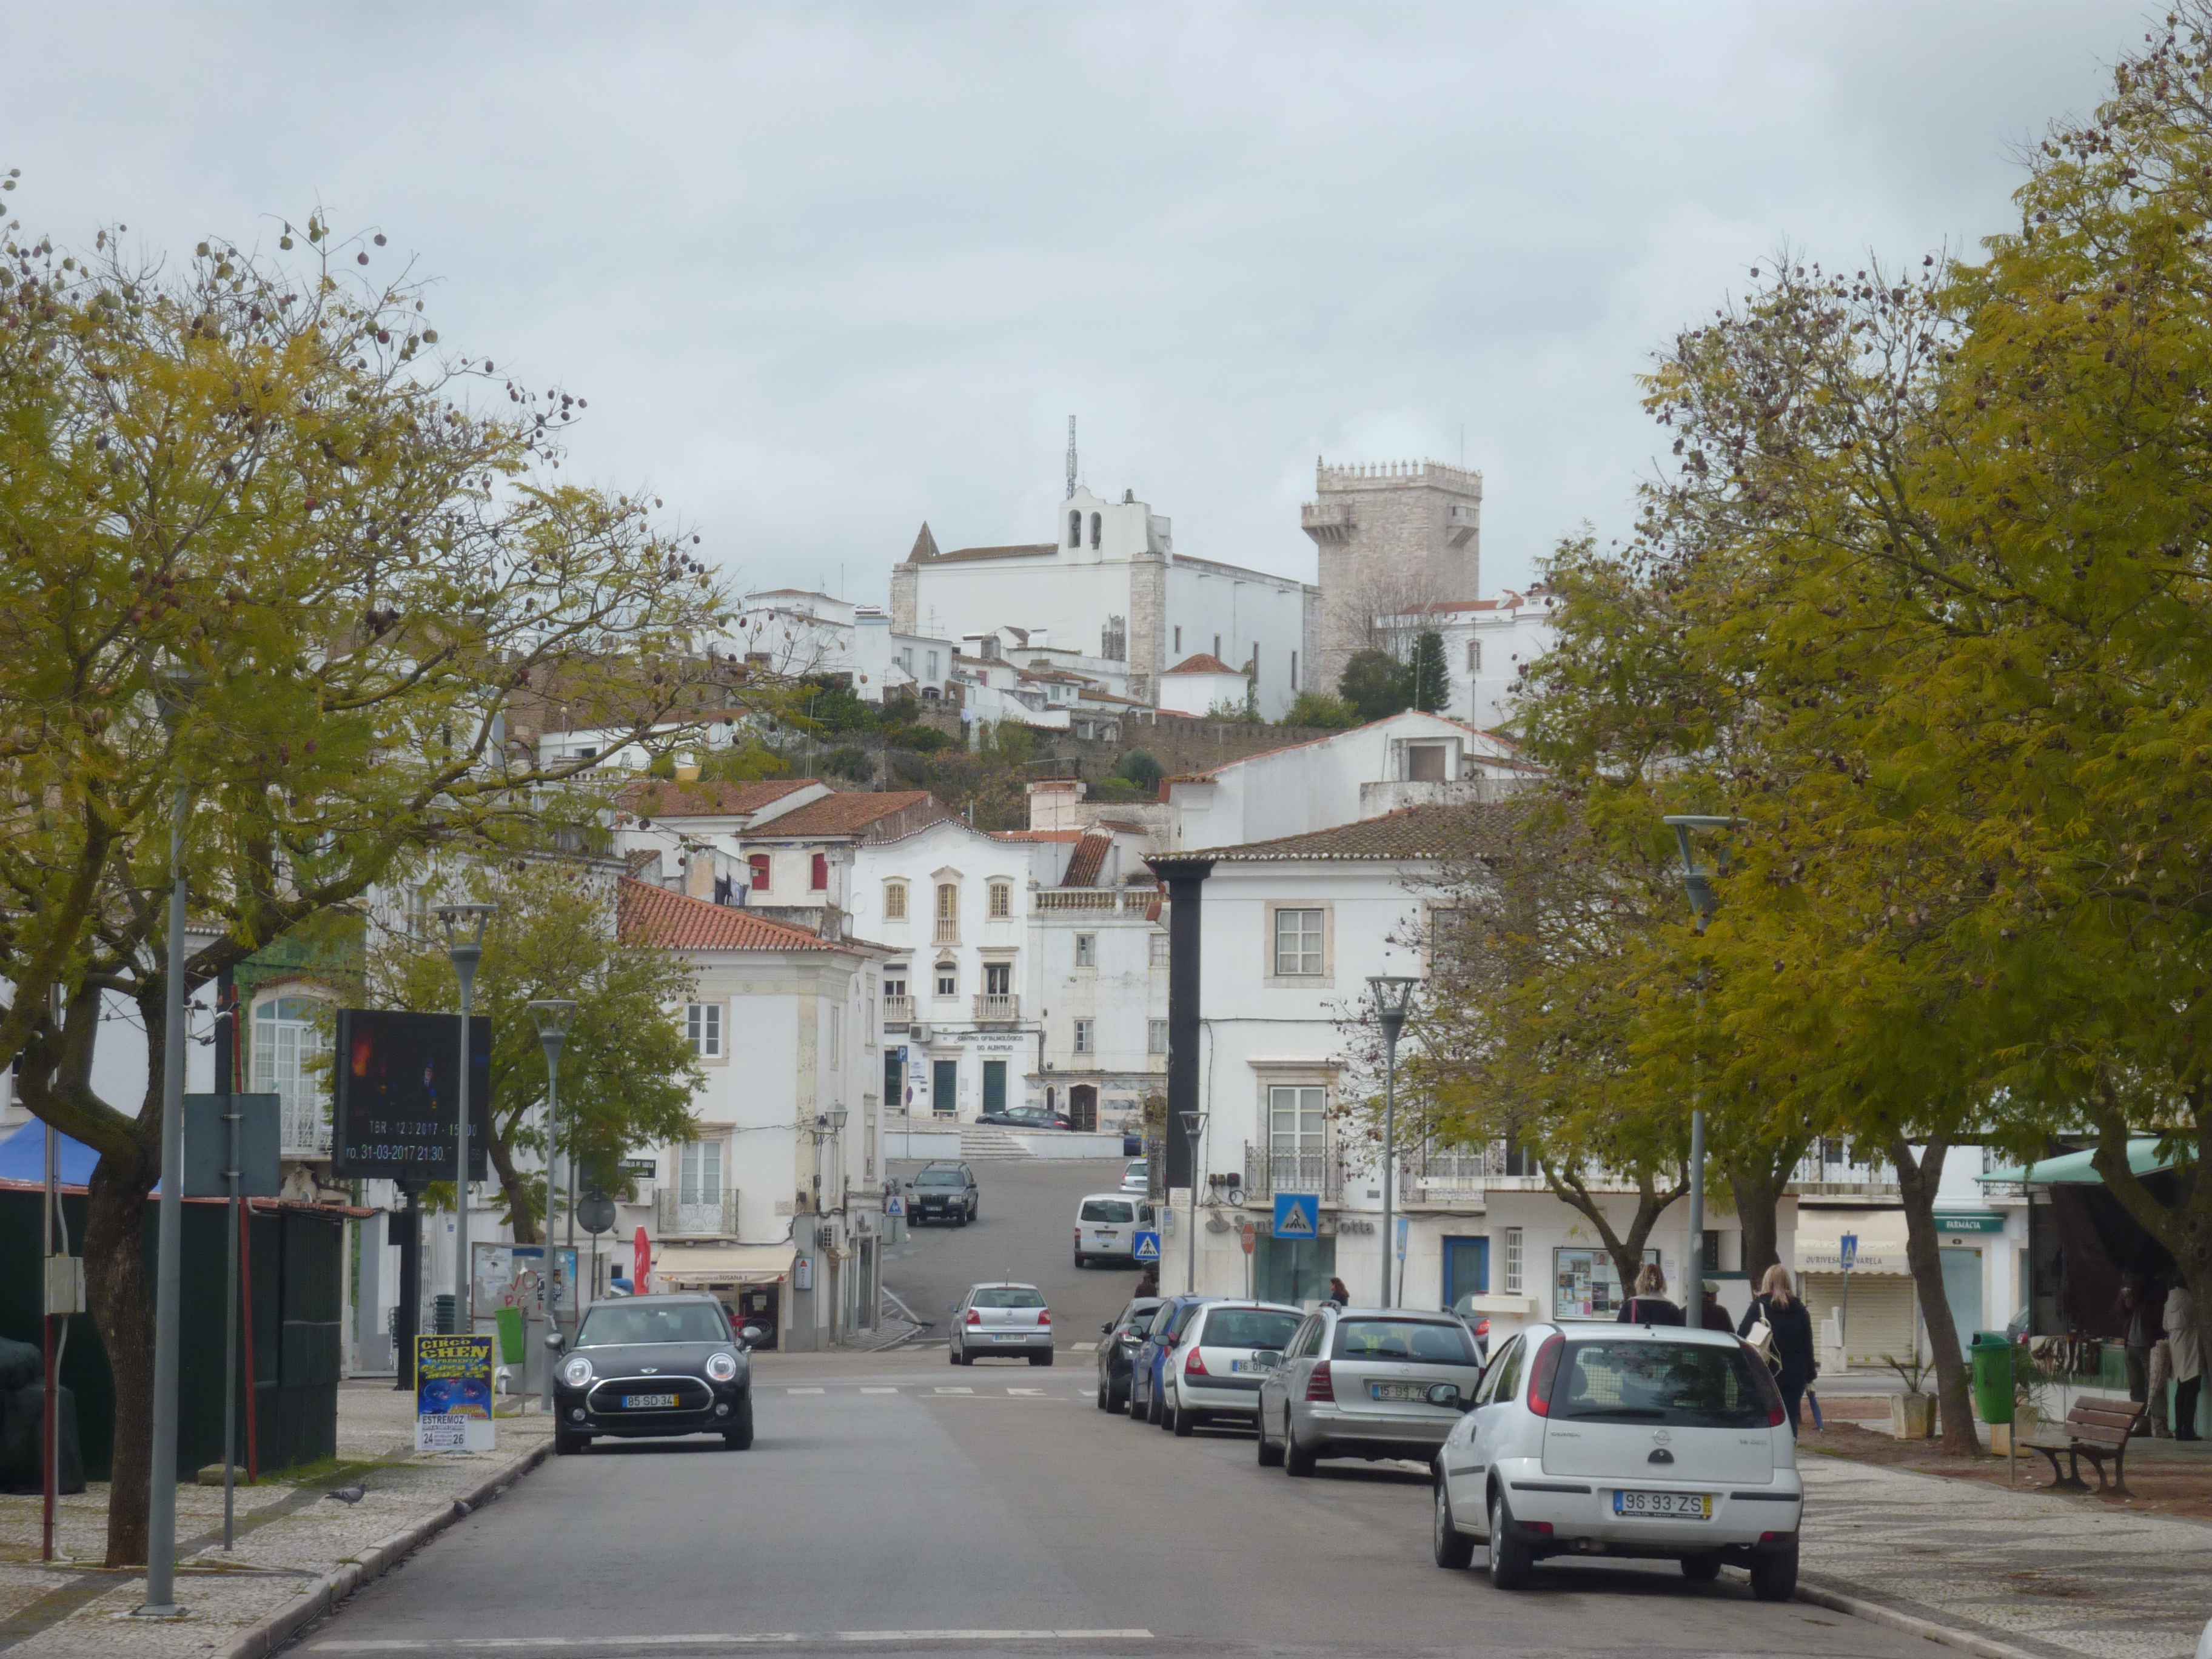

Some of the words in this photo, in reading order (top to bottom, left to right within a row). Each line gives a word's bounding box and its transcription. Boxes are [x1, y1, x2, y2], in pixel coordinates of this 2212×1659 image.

[1946, 1219, 1981, 1229] FARMÁCIA
[421, 1339, 471, 1350] CIRCO
[420, 1345, 490, 1358] CHEN
[422, 1415, 464, 1424] ESTREMOZ
[423, 1433, 433, 1444] 24
[452, 1434, 464, 1444] 26
